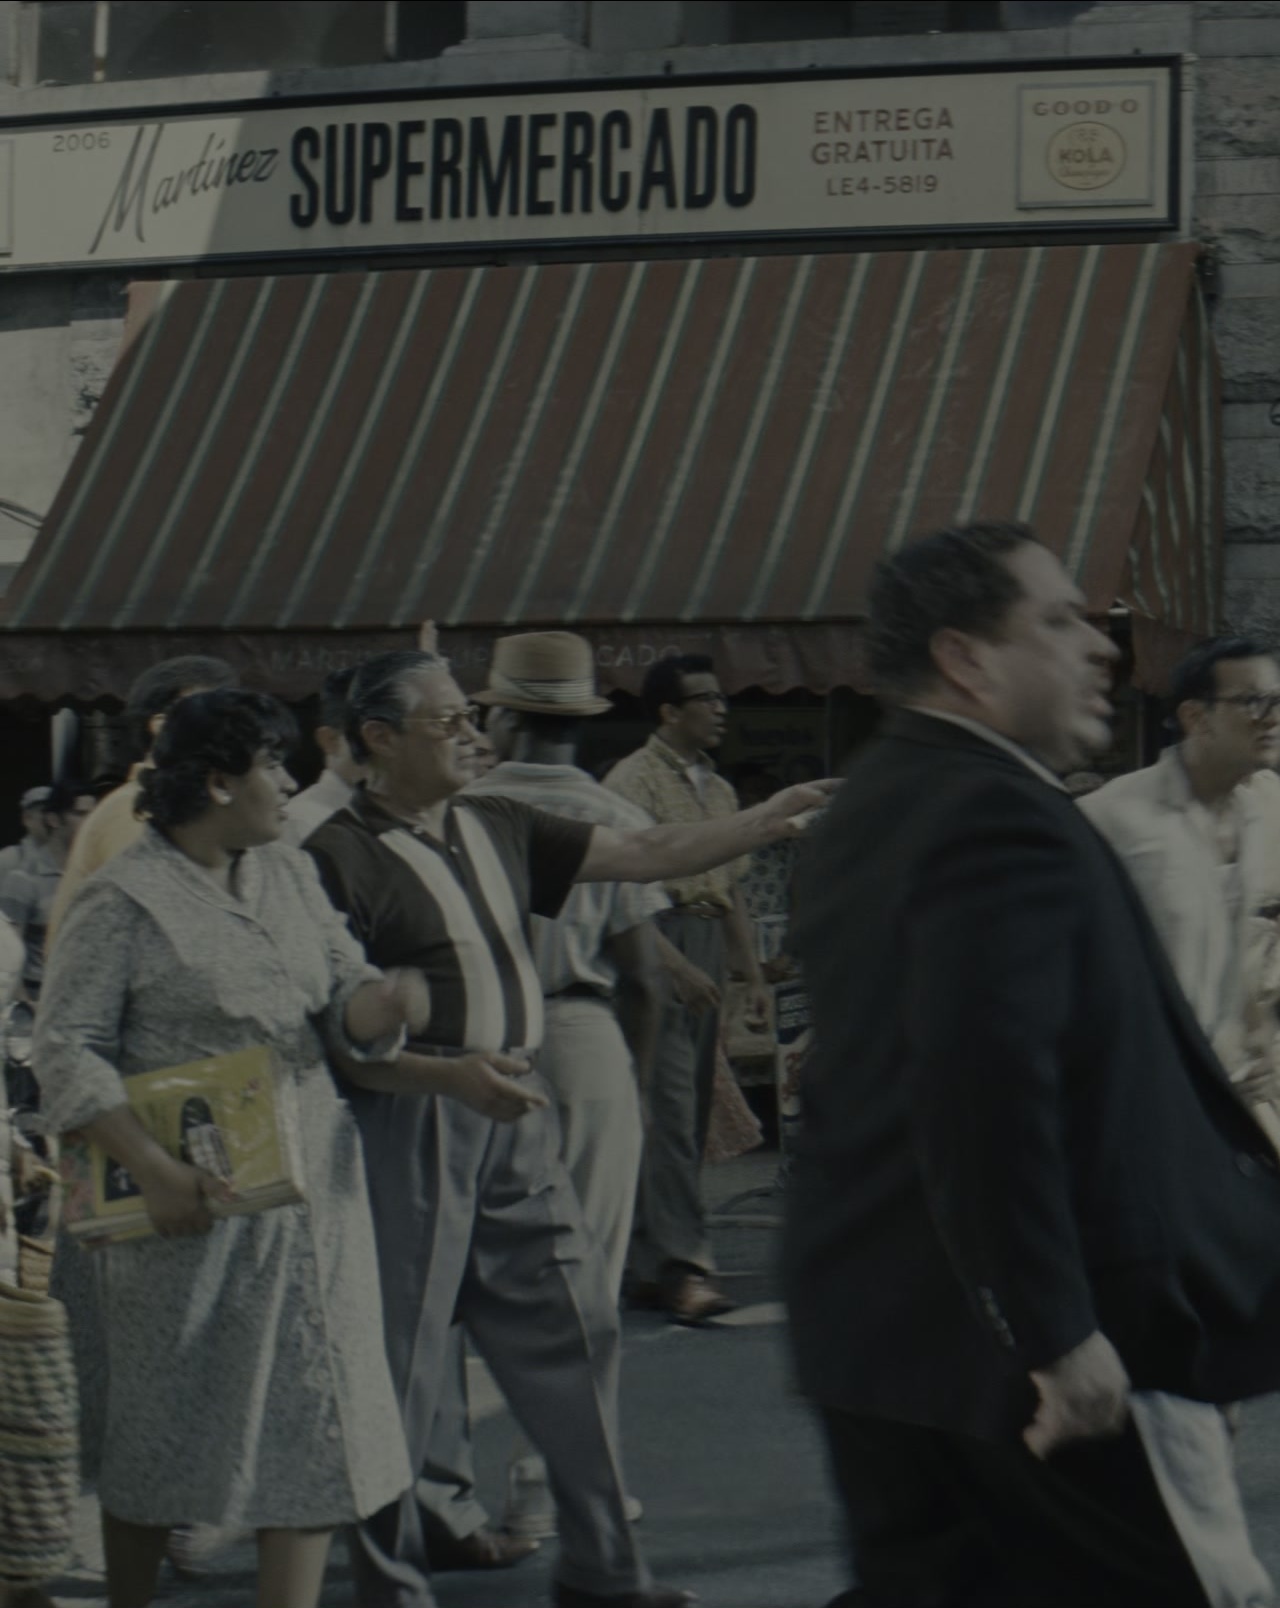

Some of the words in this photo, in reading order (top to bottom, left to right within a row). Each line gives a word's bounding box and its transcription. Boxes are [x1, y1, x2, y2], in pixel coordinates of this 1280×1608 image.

[813, 107, 954, 134] ENTREGA
[52, 132, 112, 153] 2006
[810, 137, 955, 165] GRATUITA
[289, 103, 758, 229] SUPERMERCADO
[1057, 146, 1115, 165] KOLA
[825, 174, 939, 197] LE4-5819
